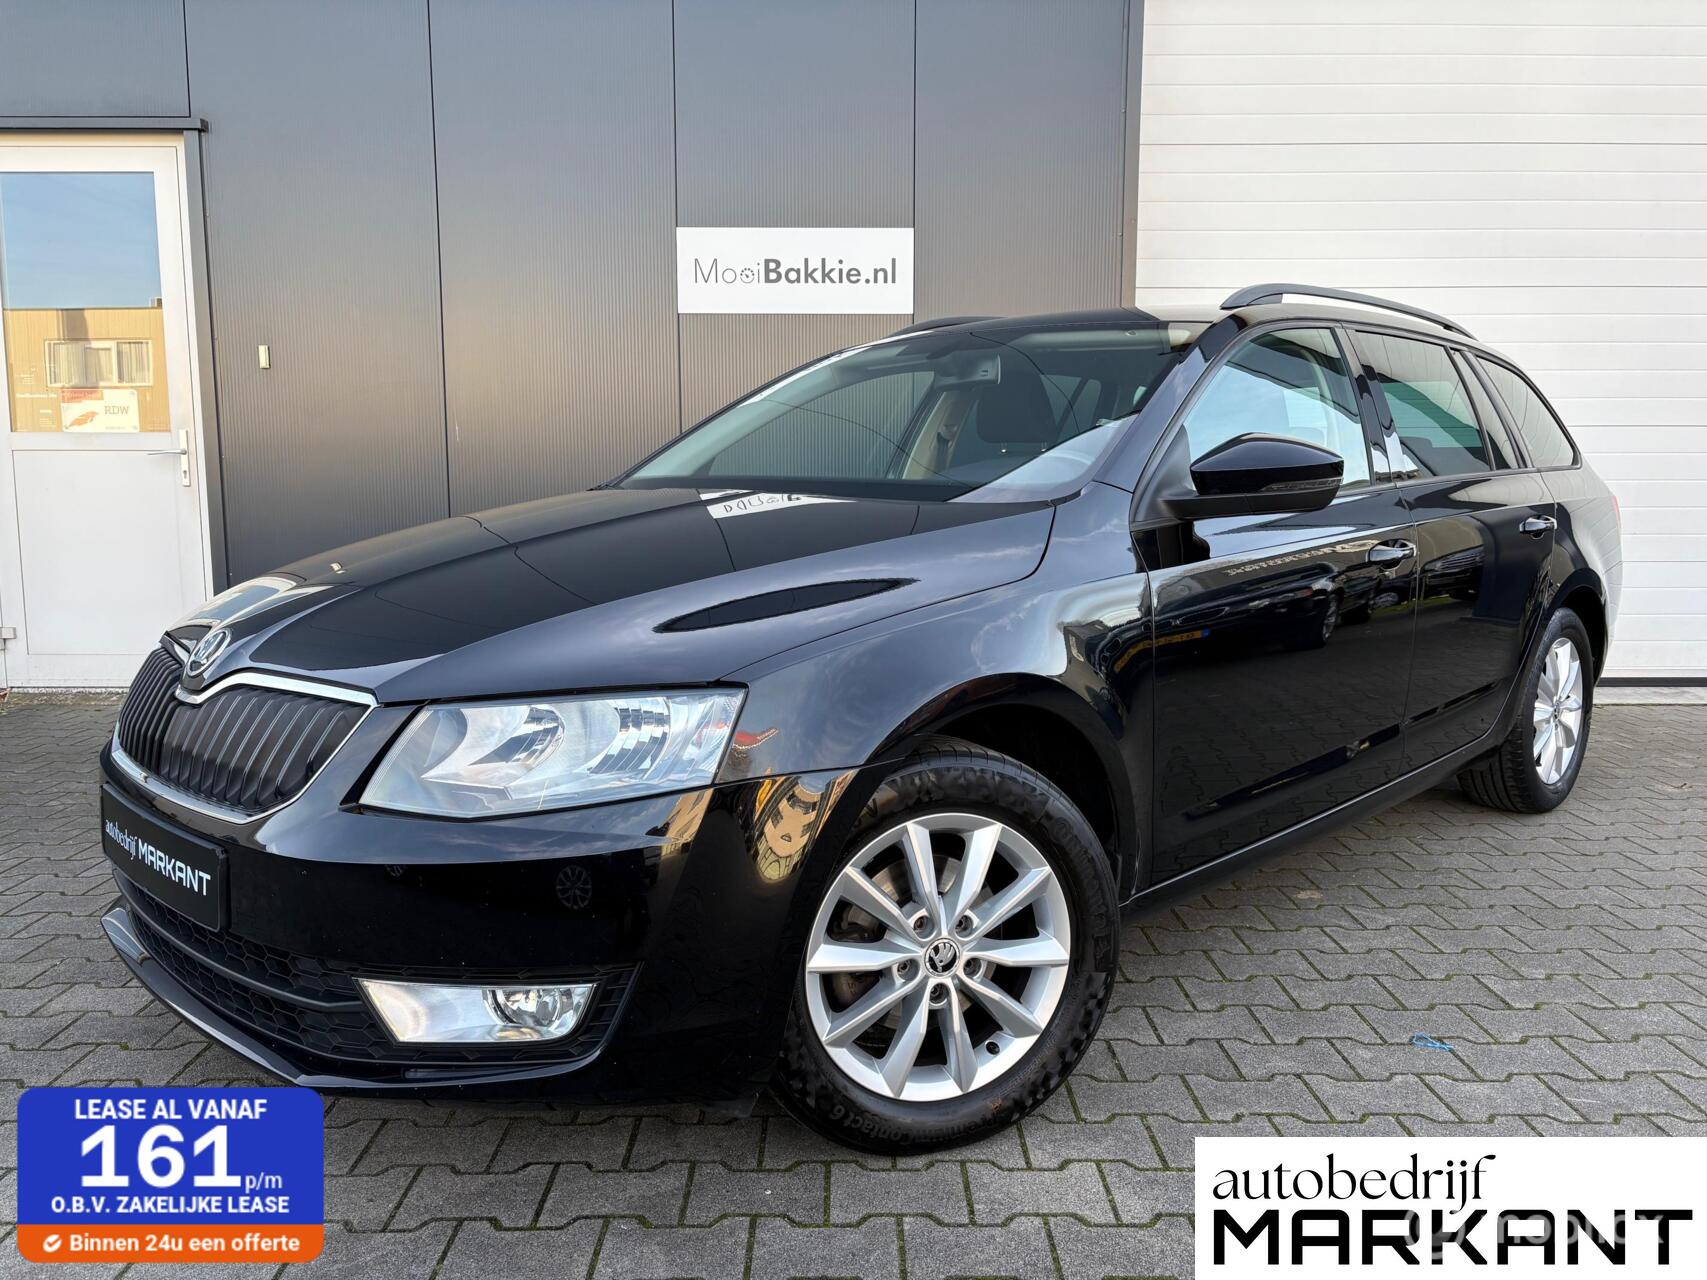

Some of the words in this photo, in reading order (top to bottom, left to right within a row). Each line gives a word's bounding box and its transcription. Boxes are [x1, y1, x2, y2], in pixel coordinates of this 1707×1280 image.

[694, 257, 897, 285] MooiBakkie.nl
[104, 405, 129, 415] RDW
[105, 819, 138, 860] autobedrijf
[138, 838, 211, 896] MARKANT
